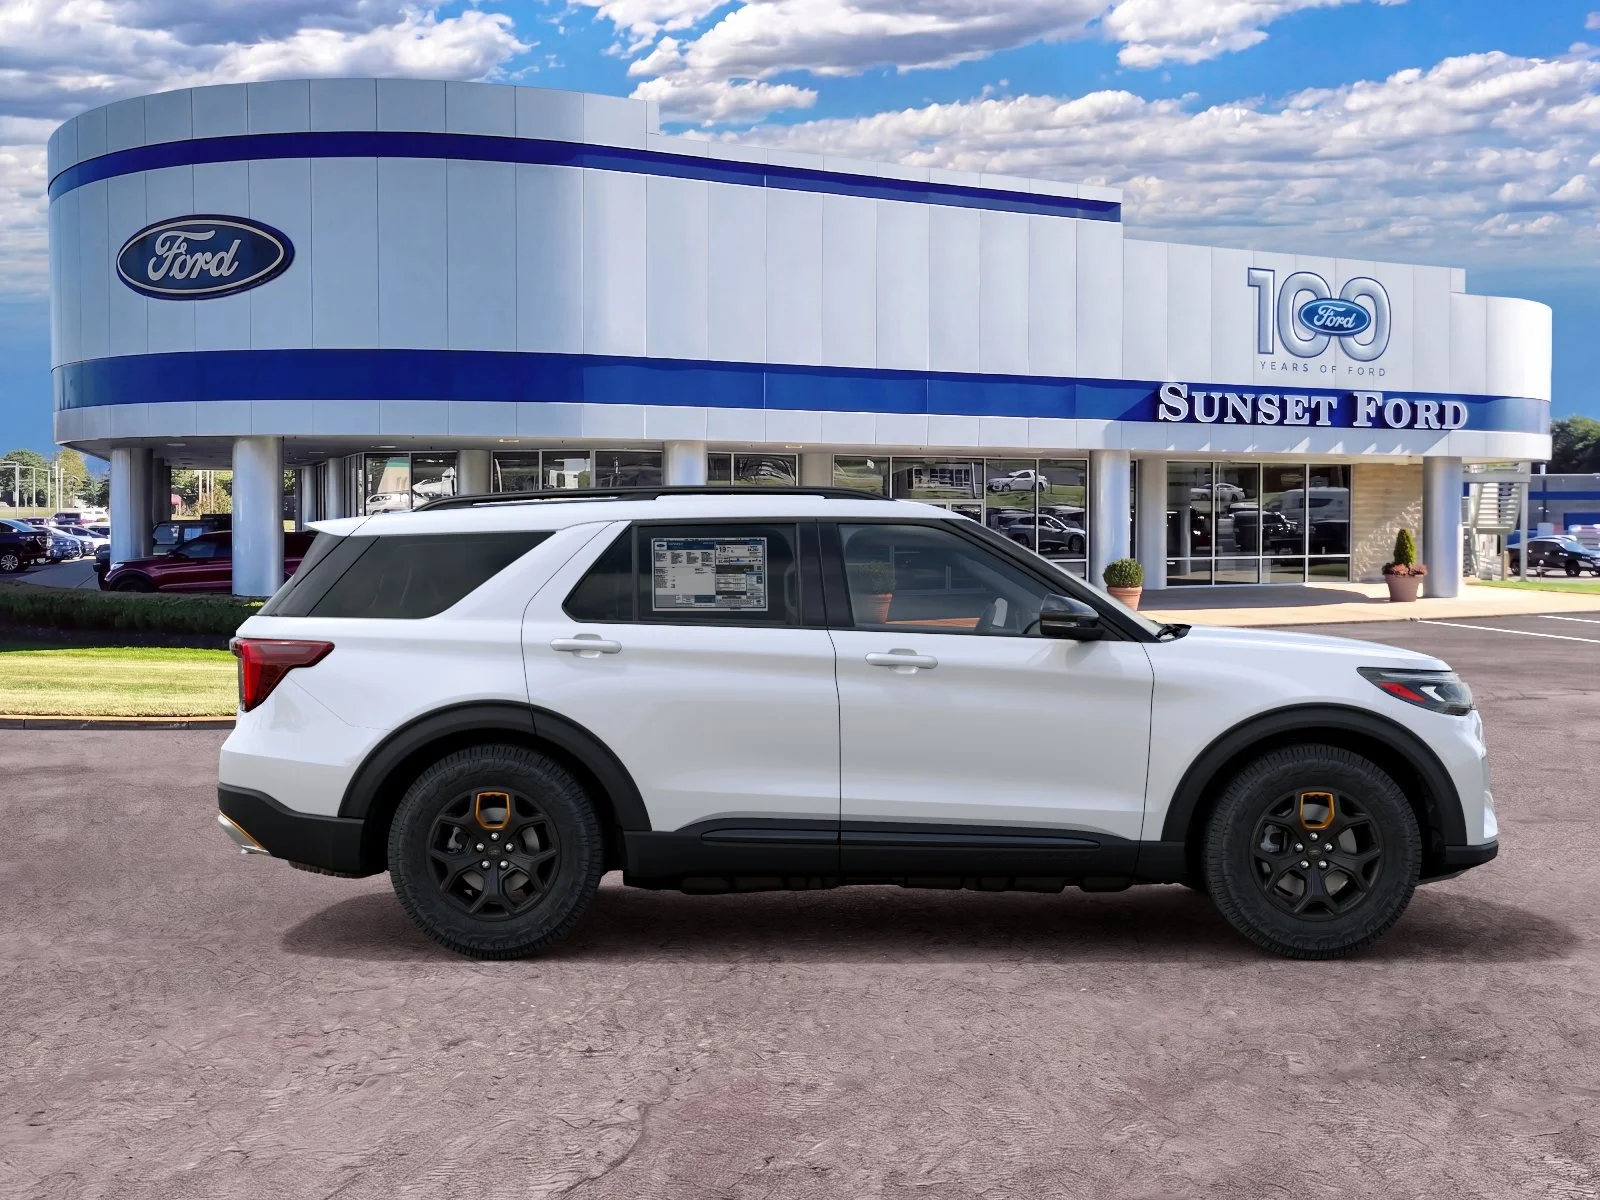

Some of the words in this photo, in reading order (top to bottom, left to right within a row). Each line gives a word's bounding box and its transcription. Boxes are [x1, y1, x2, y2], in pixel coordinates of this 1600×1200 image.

[147, 230, 242, 281] Ford
[1247, 267, 1391, 362] 100
[1313, 305, 1356, 329] Ford
[1260, 361, 1309, 373] YEARS
[1319, 365, 1337, 374] OF
[1347, 366, 1386, 377] FORD
[1158, 382, 1338, 427] SUNSET
[1352, 391, 1469, 430] FORD
